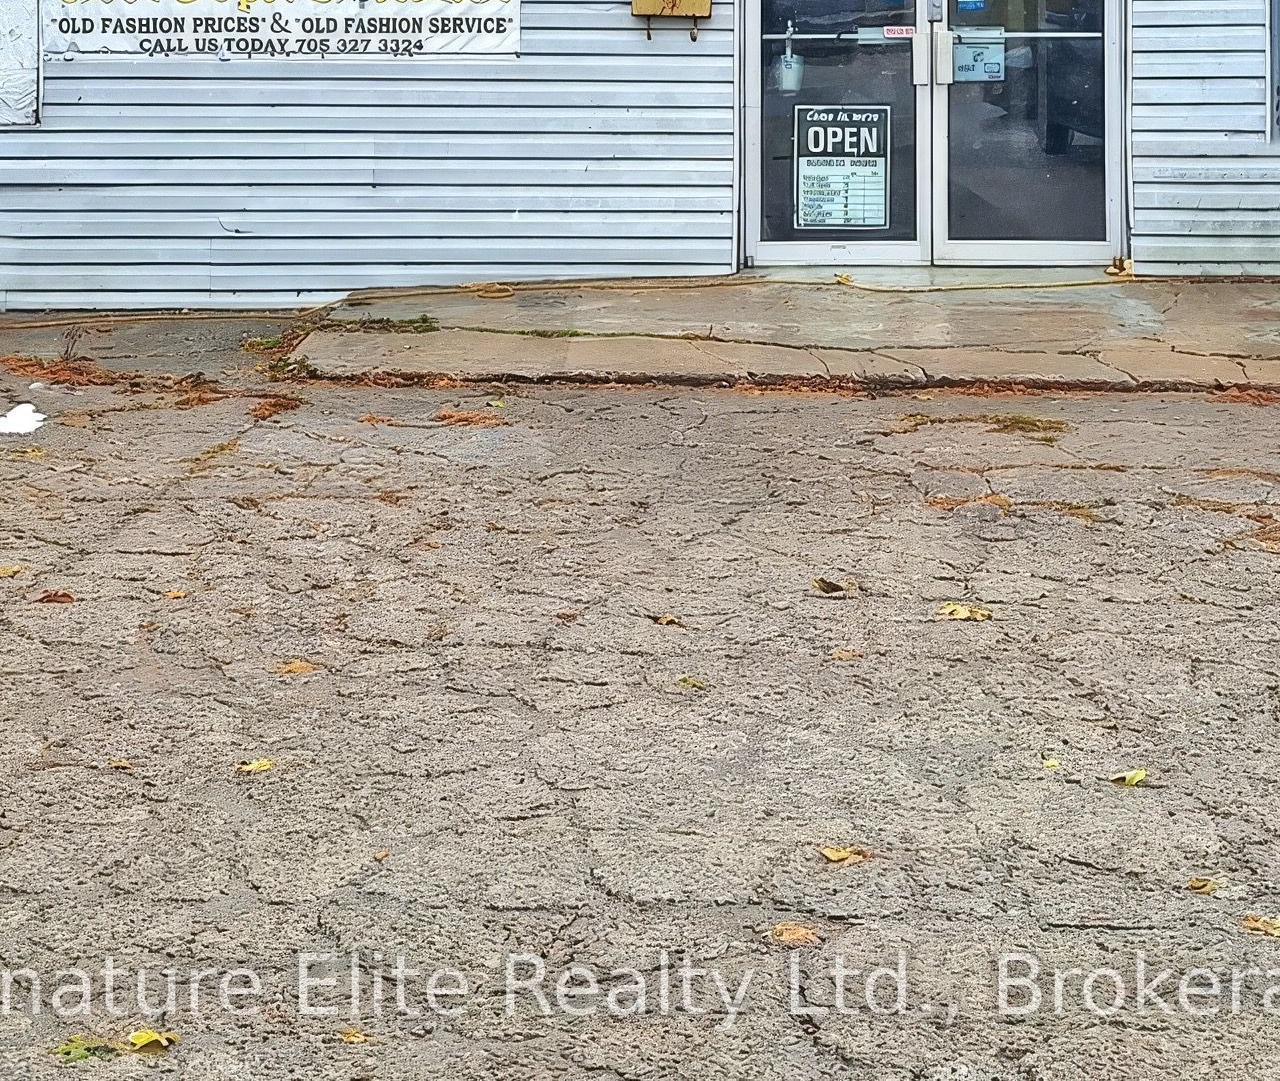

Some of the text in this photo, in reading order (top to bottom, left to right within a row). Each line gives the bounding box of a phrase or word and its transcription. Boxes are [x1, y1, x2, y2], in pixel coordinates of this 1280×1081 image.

[101, 17, 185, 34] FASHION
[270, 12, 293, 34] &
[344, 17, 422, 34] FASHION
[139, 38, 188, 52] CALL
[195, 38, 219, 52] US
[223, 38, 290, 52] TODAY
[295, 38, 330, 53] 705
[336, 38, 371, 53] 327
[807, 126, 877, 154] OPEN
